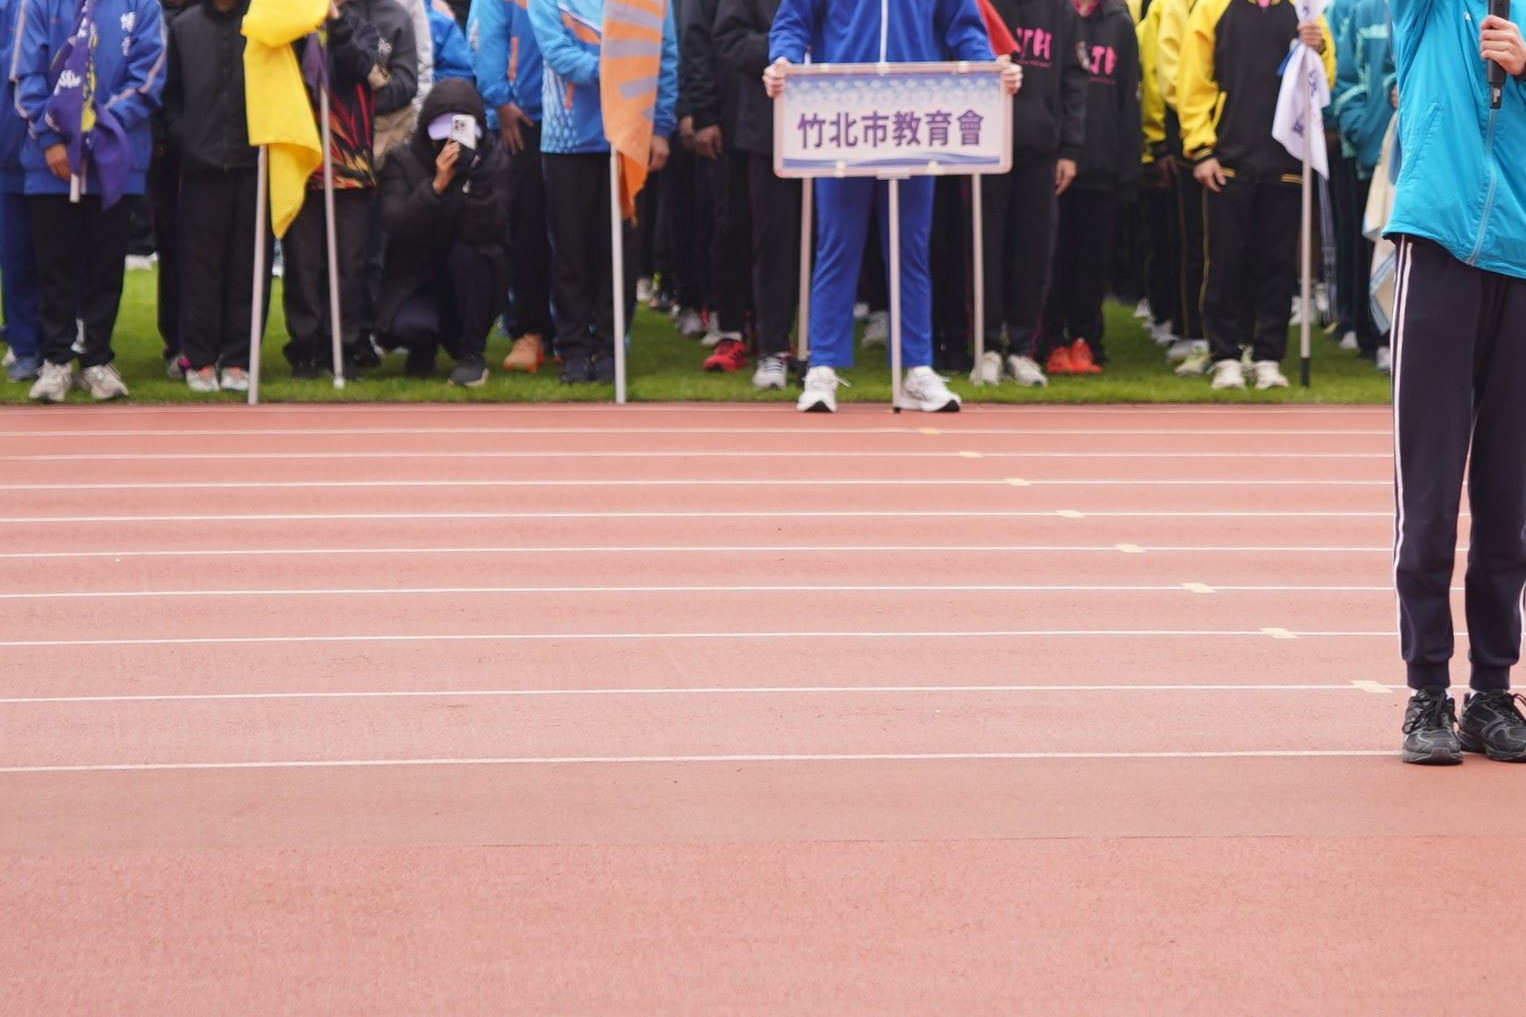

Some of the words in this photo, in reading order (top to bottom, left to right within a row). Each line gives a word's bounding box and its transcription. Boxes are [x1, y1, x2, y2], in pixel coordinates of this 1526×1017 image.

[797, 109, 984, 149] 竹北市教育會
